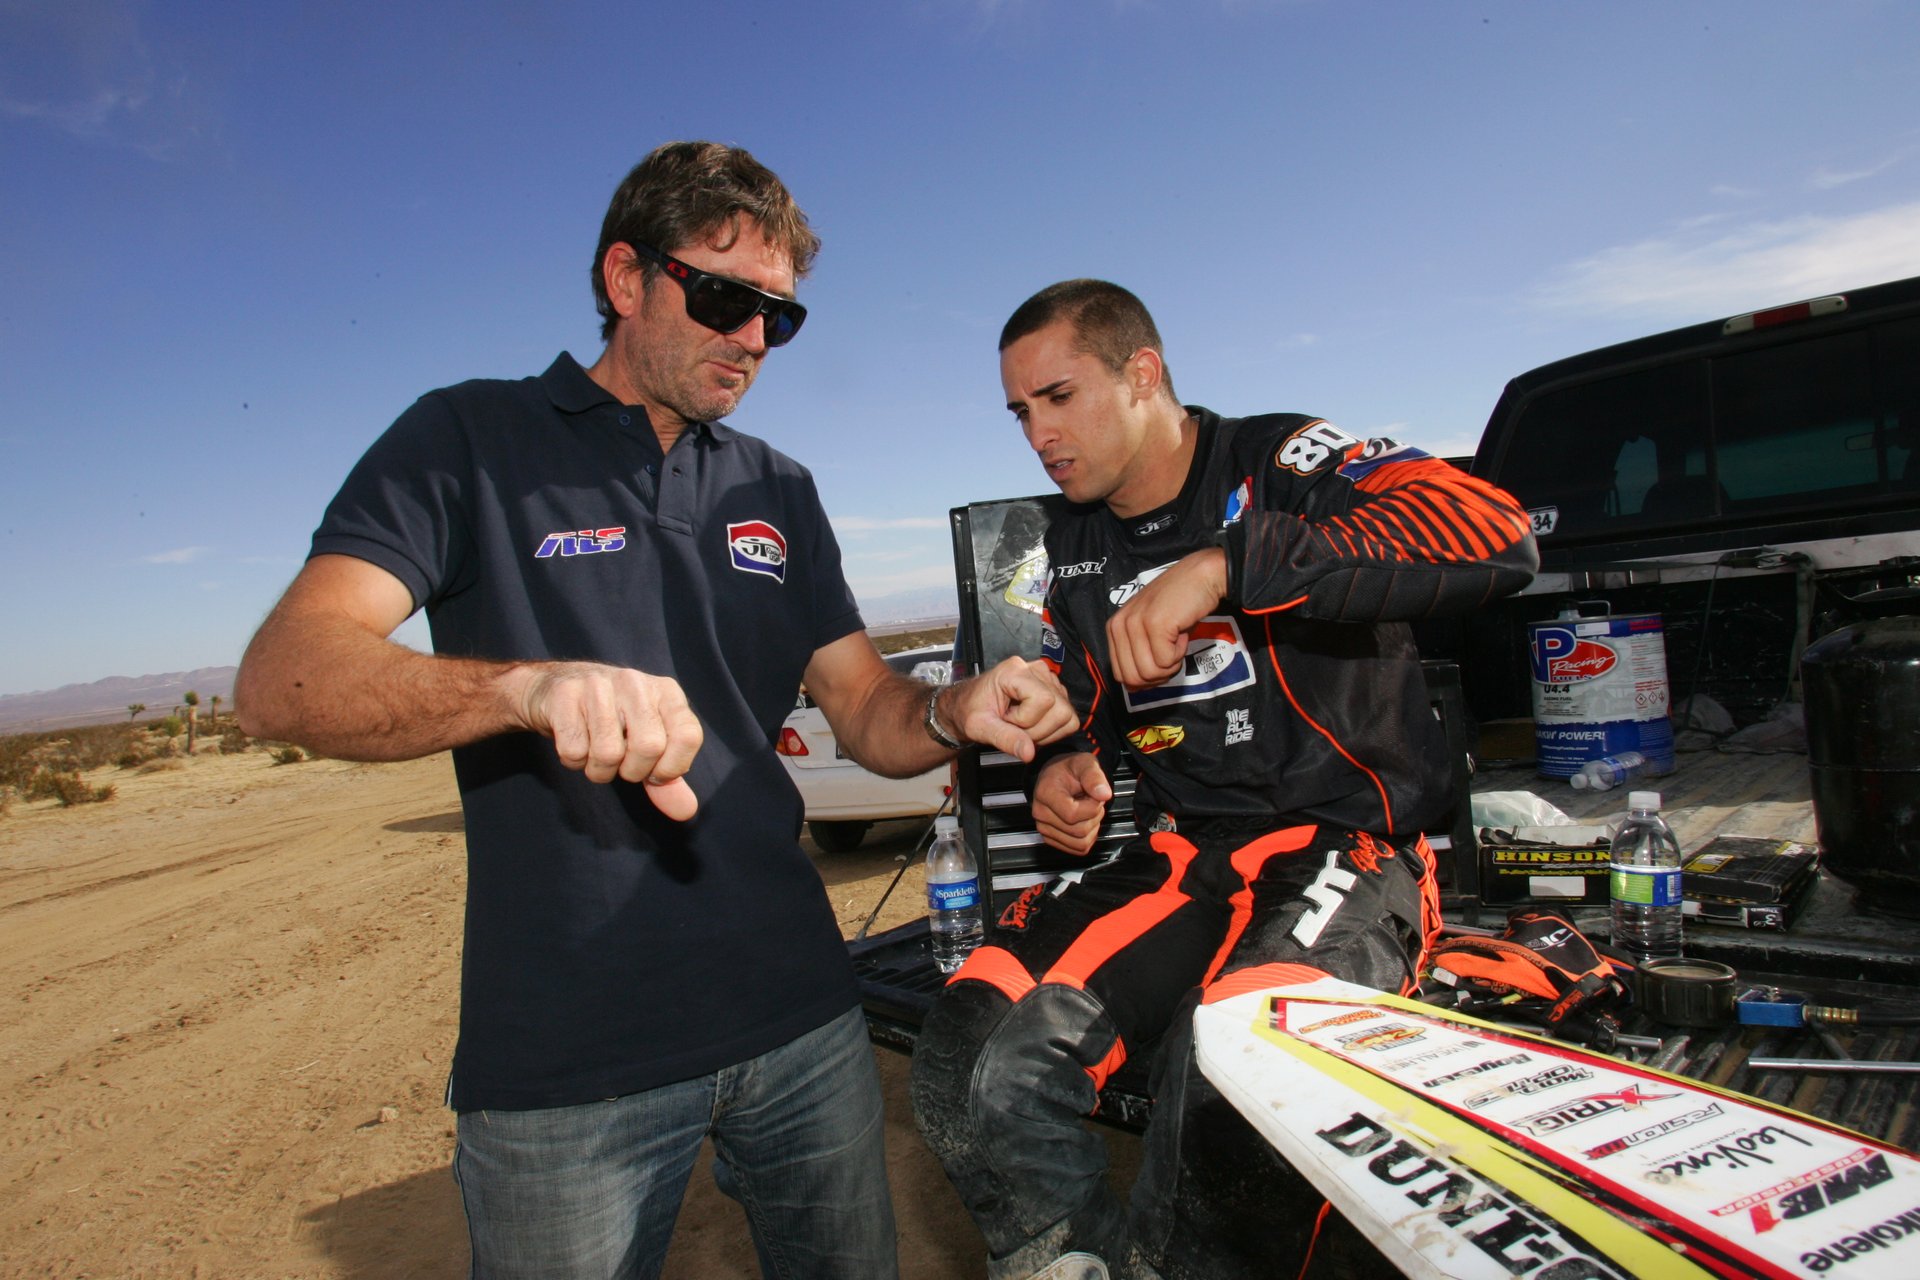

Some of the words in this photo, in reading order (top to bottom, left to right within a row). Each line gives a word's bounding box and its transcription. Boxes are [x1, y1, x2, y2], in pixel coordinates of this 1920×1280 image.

[1533, 513, 1552, 531] 34
[1203, 661, 1218, 674] USA
[1551, 655, 1616, 675] Racing
[1227, 723, 1253, 733] ALL
[1558, 730, 1606, 741] POWER!
[1225, 728, 1255, 747] RIDE
[1716, 1149, 1869, 1216] SUSPENSION
